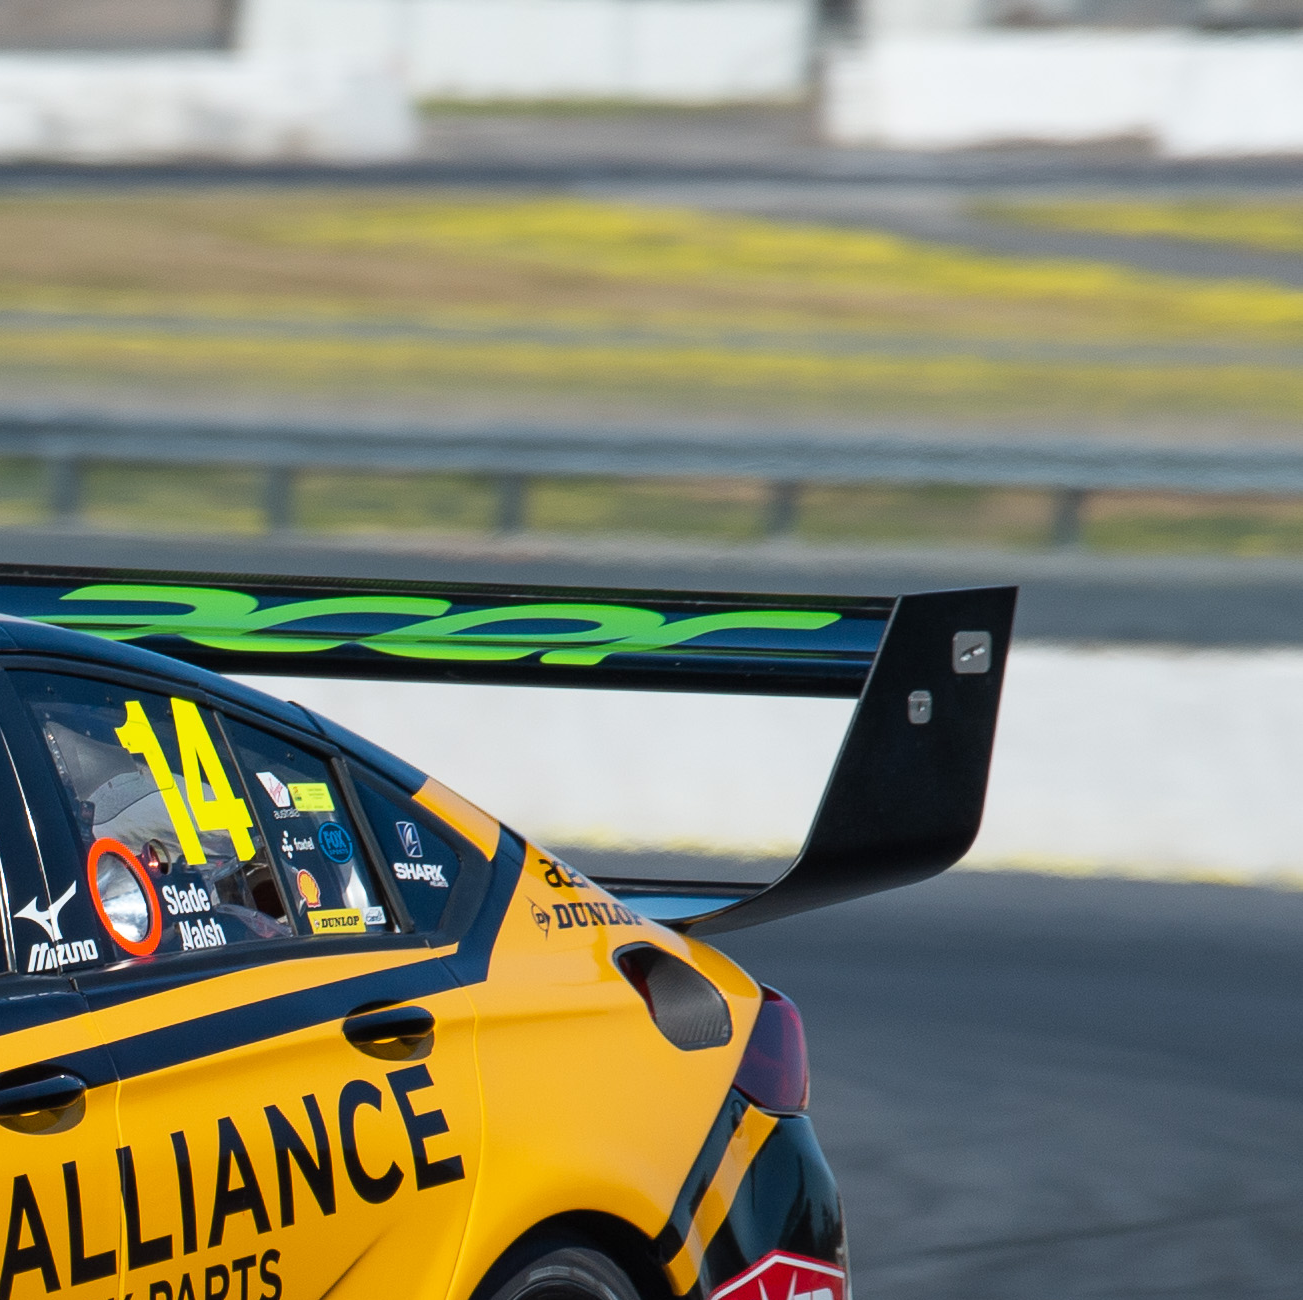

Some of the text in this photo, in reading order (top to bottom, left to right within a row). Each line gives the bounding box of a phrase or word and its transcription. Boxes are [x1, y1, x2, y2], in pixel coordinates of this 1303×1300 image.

[23, 584, 841, 665] acer
[114, 697, 256, 865] 14
[323, 830, 346, 849] FOX
[394, 863, 446, 881] SHARK
[162, 883, 210, 915] Slade
[321, 916, 360, 928] DUNLOP
